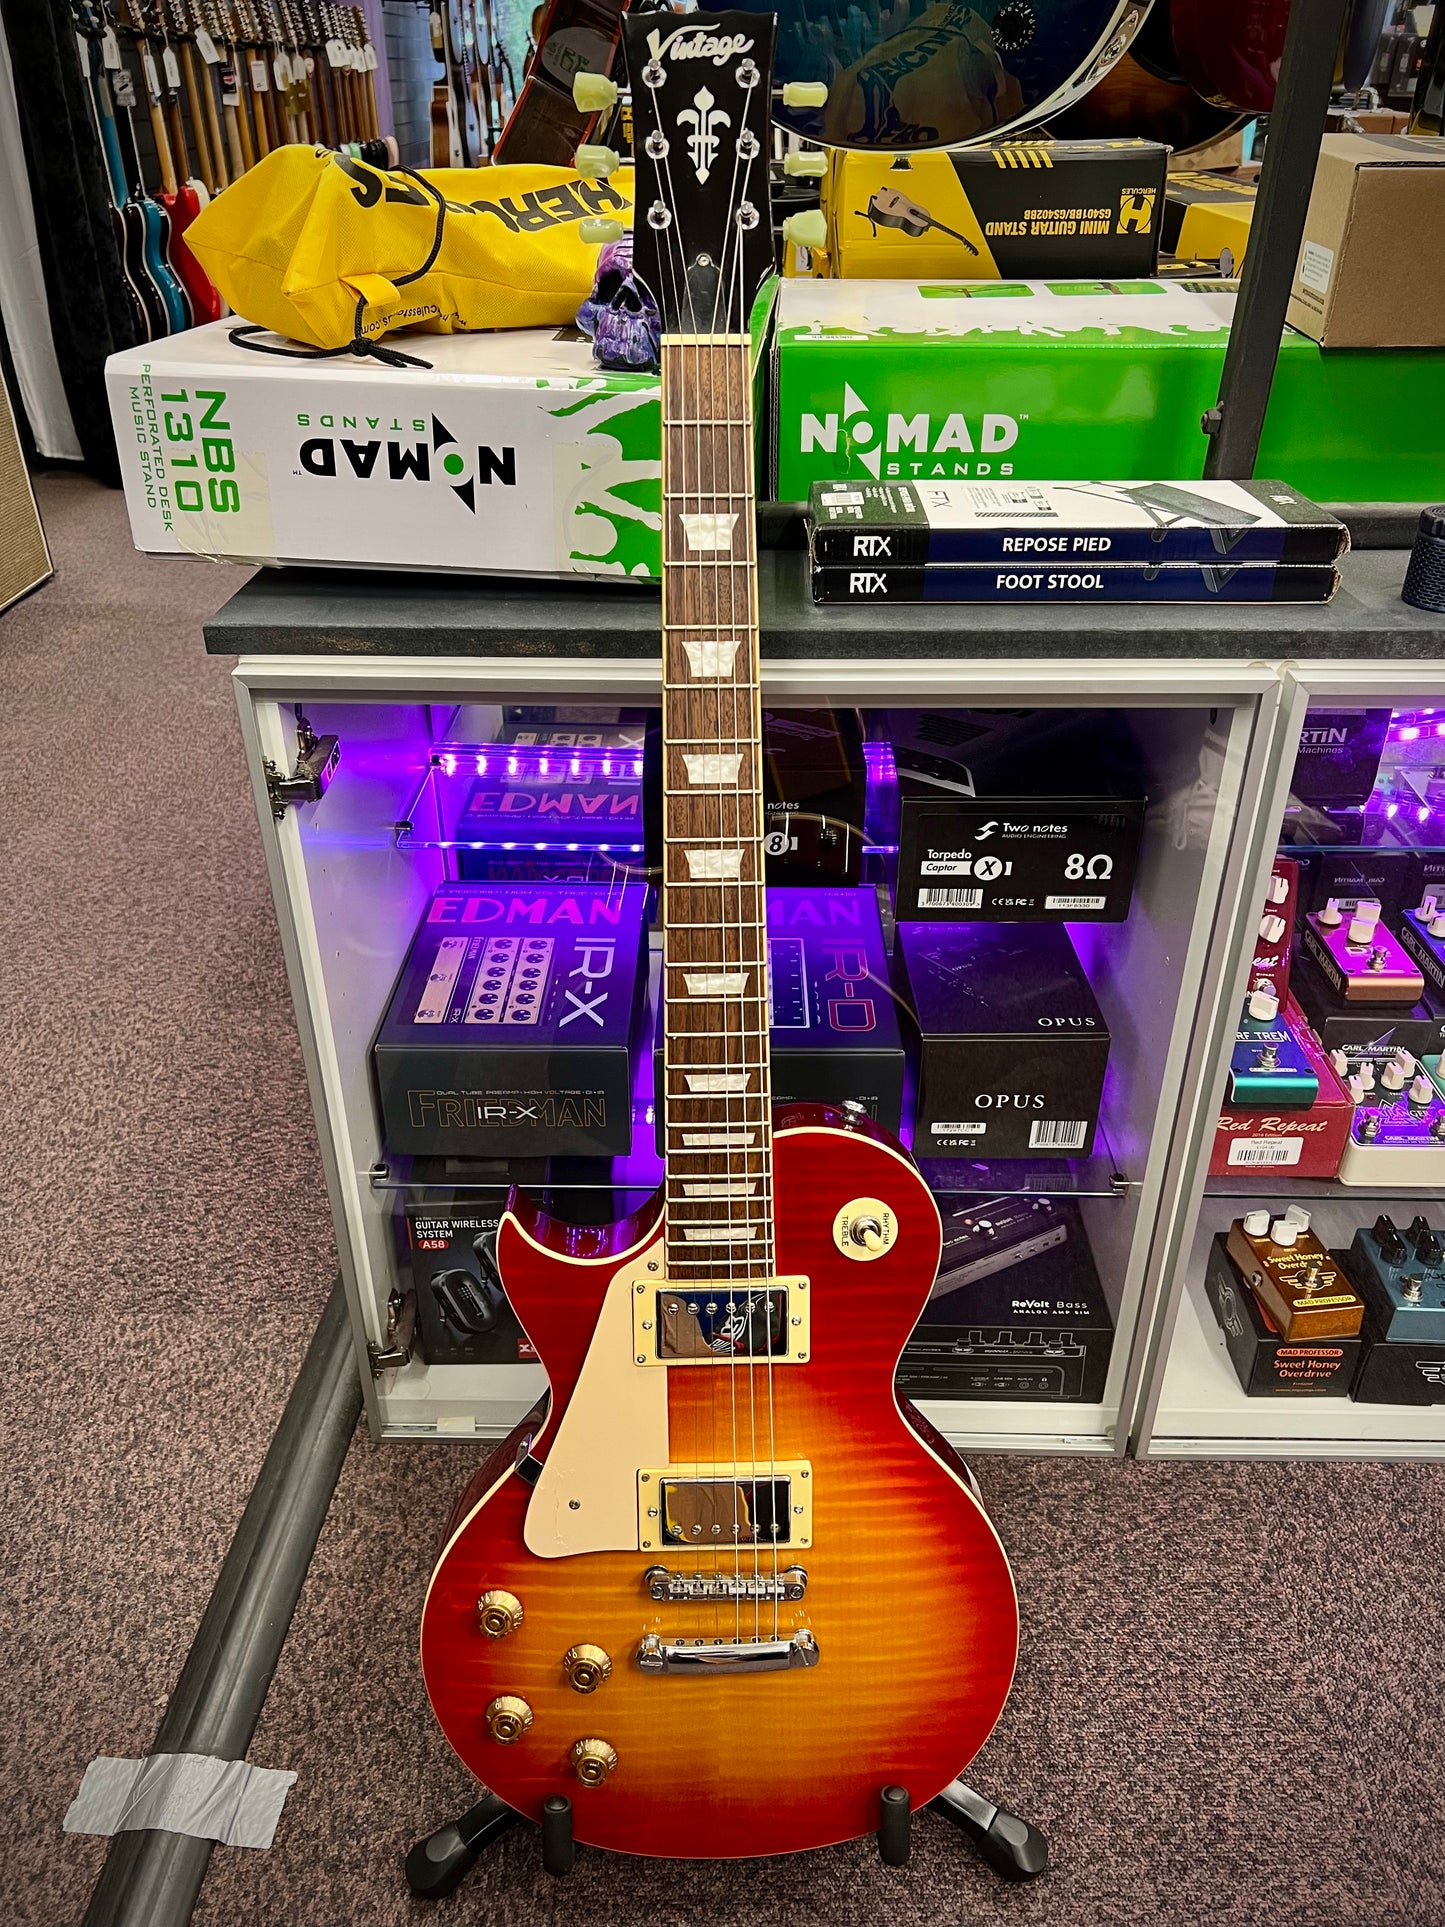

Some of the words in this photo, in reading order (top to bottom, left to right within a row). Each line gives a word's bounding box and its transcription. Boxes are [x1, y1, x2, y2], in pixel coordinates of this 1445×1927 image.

[646, 23, 754, 66] Vintage
[1121, 187, 1156, 195] HERCULES
[1023, 208, 1112, 219] GS401BB/GS402BB
[985, 221, 1026, 236] STAND
[1030, 221, 1077, 235] GUITAR
[1080, 221, 1110, 235] MINI
[297, 413, 425, 432] STANDS
[129, 386, 147, 444] MUSIC
[140, 451, 157, 509] STAND
[141, 364, 166, 480] PERFORATED
[158, 486, 174, 533] DESK
[161, 389, 204, 512] 1310
[195, 390, 240, 513] NBS
[886, 463, 1014, 476] STANDS
[853, 535, 892, 556] RTX
[1002, 538, 1068, 552] REPOSE
[1073, 537, 1111, 552] PIED
[850, 572, 888, 593] RTX
[996, 574, 1043, 589] FOOT
[1047, 574, 1104, 589] STOOL
[767, 802, 800, 810] notes
[1003, 822, 1029, 833] Two
[1032, 823, 1068, 833] notes
[927, 848, 972, 861] Torpedo
[926, 863, 957, 873] Captor
[427, 897, 622, 925] EDMAN
[558, 937, 616, 1028] IR-X
[822, 939, 877, 1032] IR-D
[1037, 1017, 1096, 1027] OPUS
[1253, 1031, 1292, 1042] TREM
[1342, 1044, 1364, 1052] CARL
[1366, 1045, 1405, 1053] MARTIN
[407, 1089, 607, 1127] FRIEDMAN
[974, 1094, 1046, 1109] OPUS
[477, 1106, 539, 1120] IR-X
[1217, 1116, 1254, 1131] Red
[1258, 1116, 1328, 1135] Repeat
[415, 1220, 449, 1229] GUITAR
[452, 1219, 500, 1228] WIRELESS
[841, 1215, 849, 1247] TREBLE
[882, 1212, 890, 1245] RHYTHM
[416, 1230, 454, 1239] SYSTEM
[422, 1240, 445, 1249] A58
[1267, 1254, 1295, 1264] Sweet
[1294, 1253, 1324, 1262] Honey
[1011, 1299, 1050, 1309] ReVolt
[1056, 1301, 1088, 1309] Bass
[1313, 1296, 1353, 1305] PROFESSOR
[1273, 1360, 1306, 1370] Sweet
[1308, 1360, 1341, 1371] Honey
[1279, 1370, 1332, 1378] Overdrive
